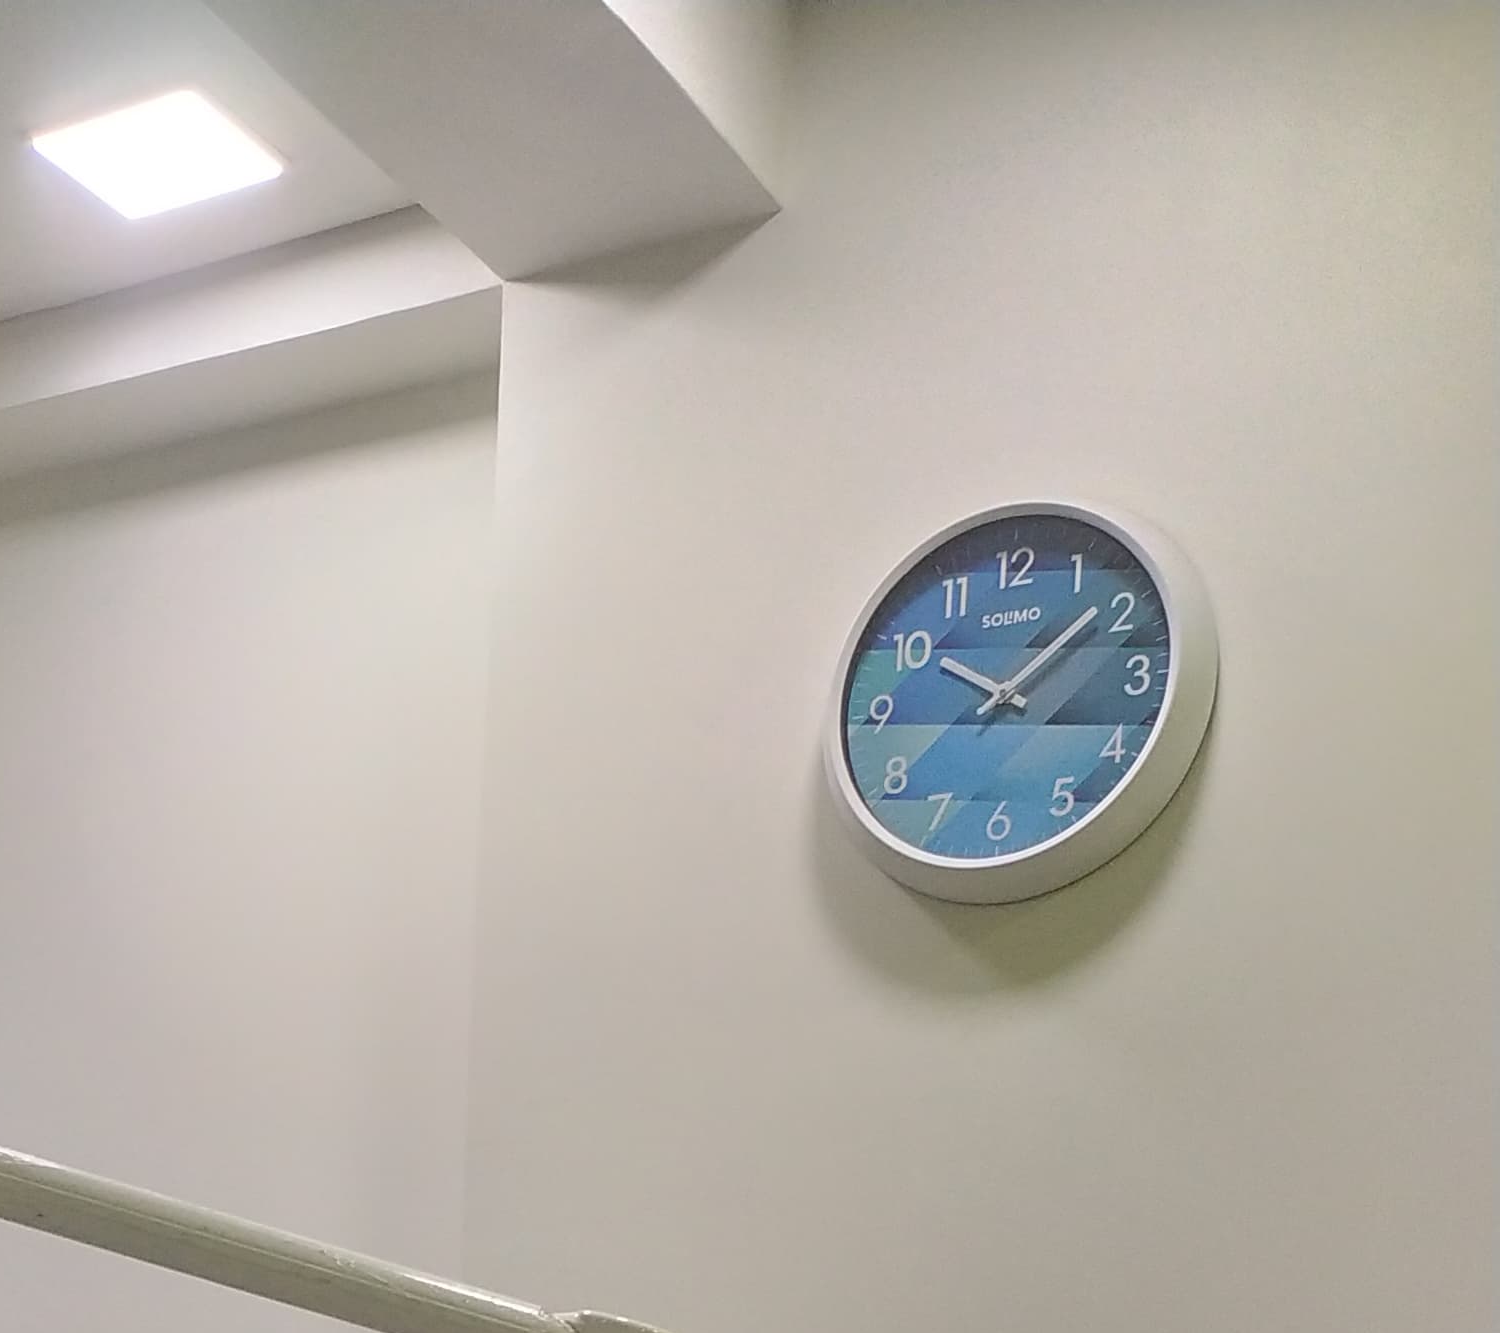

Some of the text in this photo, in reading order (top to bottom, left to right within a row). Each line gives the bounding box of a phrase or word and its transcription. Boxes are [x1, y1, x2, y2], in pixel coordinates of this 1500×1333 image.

[996, 547, 1035, 589] 12
[1070, 553, 1083, 593] 1
[942, 576, 969, 619] 11
[981, 606, 1041, 629] SOLIMO
[1108, 591, 1136, 633] 2
[893, 630, 932, 671] 10
[1123, 654, 1151, 696] 3
[869, 695, 894, 735] 9
[1099, 723, 1126, 764] 4
[883, 756, 908, 795] 8
[928, 792, 953, 831] 7
[1049, 776, 1075, 817] 5
[986, 801, 1012, 841] 6
